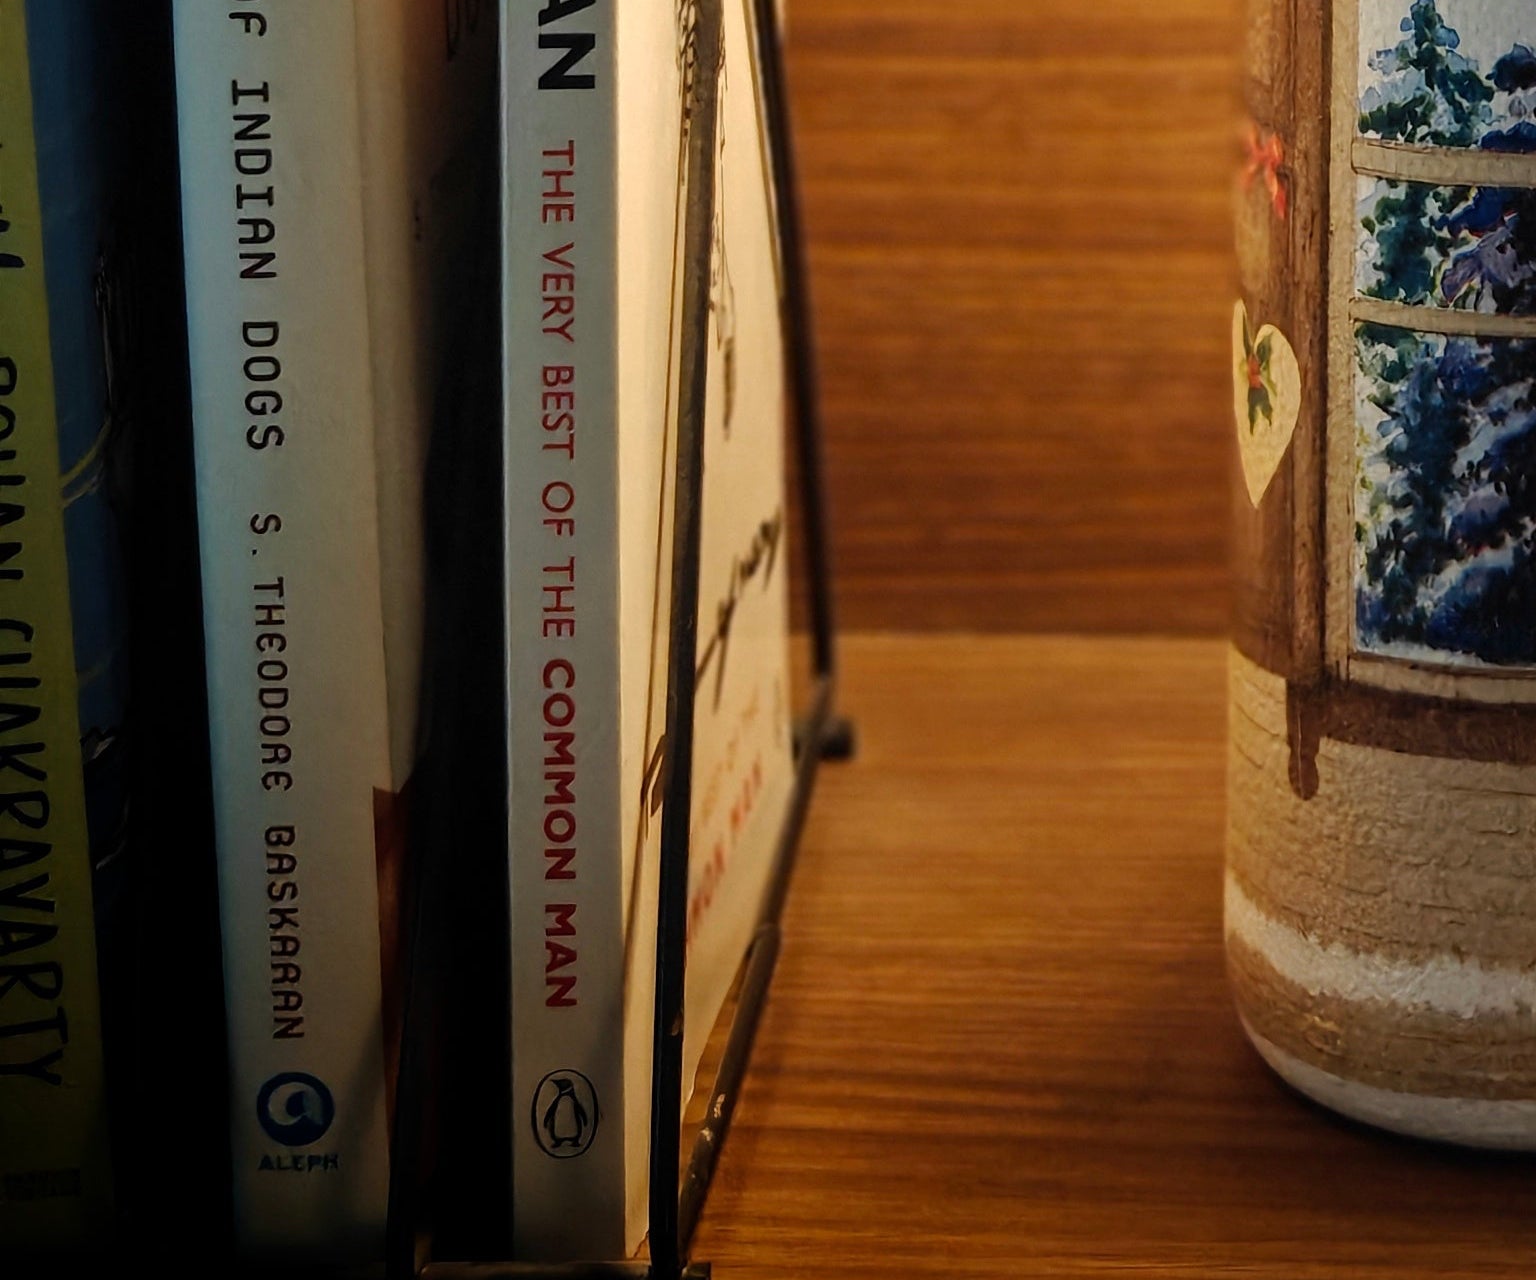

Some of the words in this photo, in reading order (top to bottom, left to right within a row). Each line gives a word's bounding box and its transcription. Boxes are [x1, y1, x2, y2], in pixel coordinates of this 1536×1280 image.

[230, 78, 279, 280] INDIAN
[541, 139, 576, 225] THE
[541, 241, 576, 343] VERY
[241, 320, 286, 454] DOGS
[540, 365, 577, 461] BEST
[249, 513, 282, 558] S.
[541, 480, 576, 538] OF
[541, 555, 576, 638] THE
[253, 575, 297, 792] THEODORE
[542, 657, 577, 882] COMMON
[263, 824, 305, 1040] BASKARAN
[543, 903, 578, 1010] MAN
[257, 1153, 340, 1172] ALEPH
